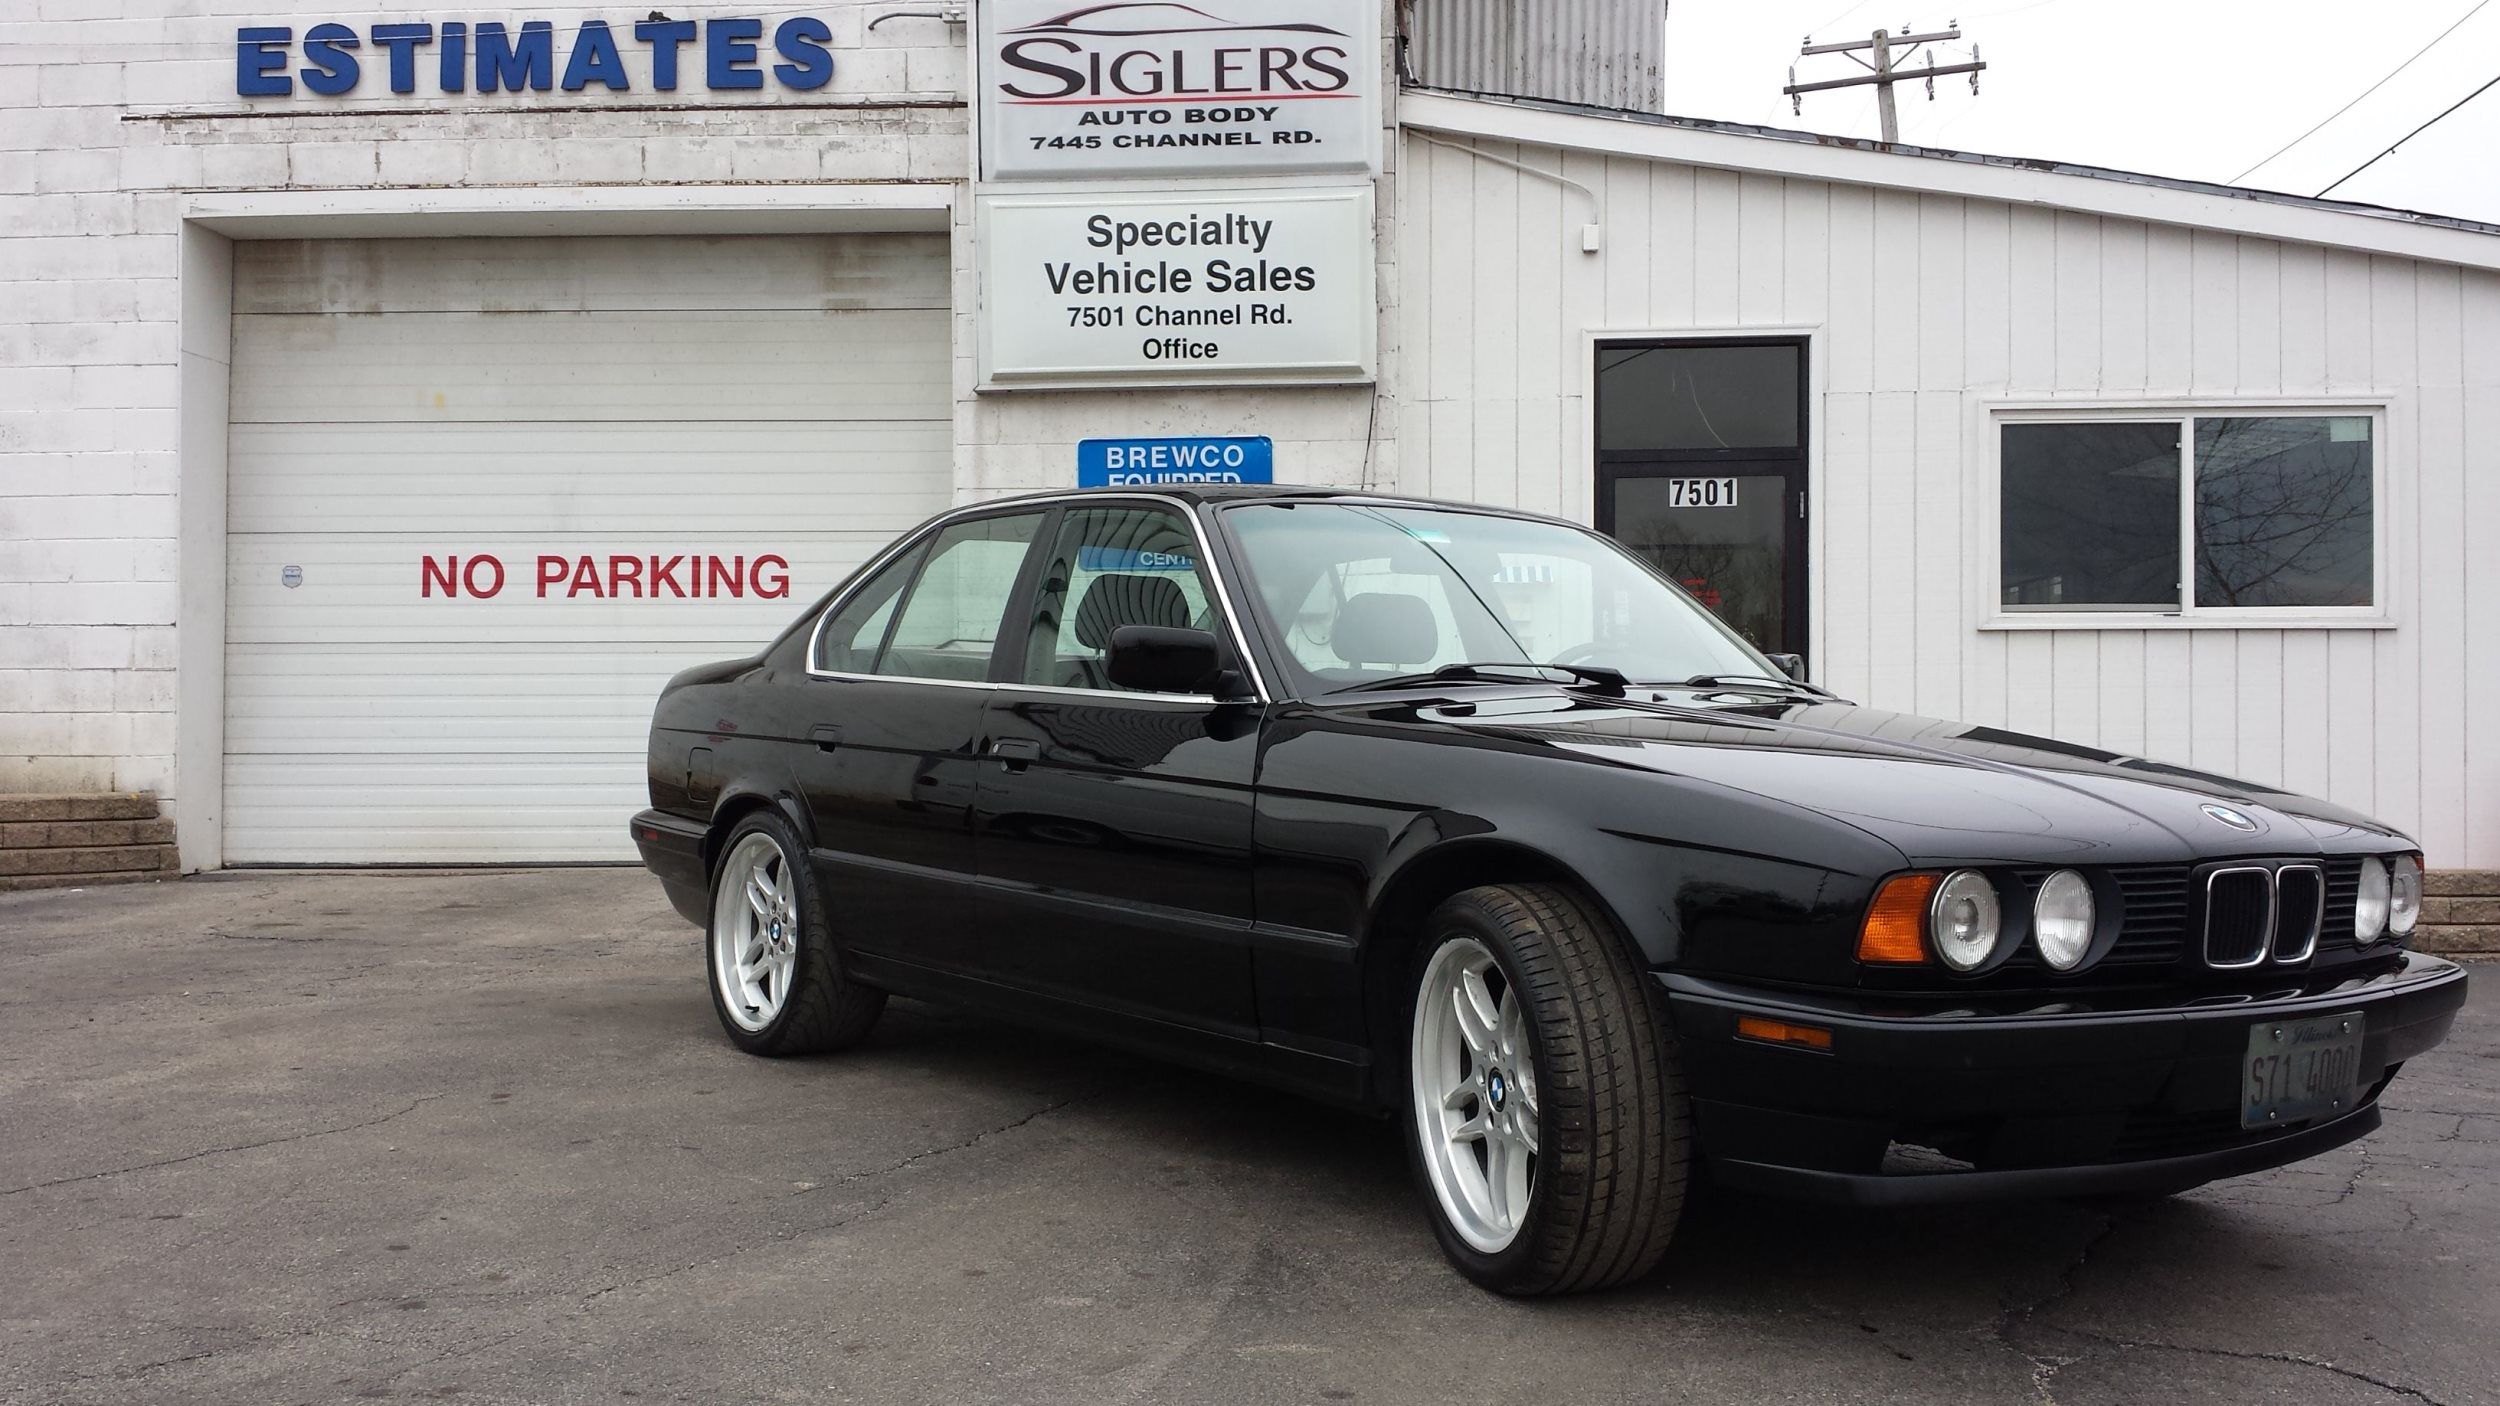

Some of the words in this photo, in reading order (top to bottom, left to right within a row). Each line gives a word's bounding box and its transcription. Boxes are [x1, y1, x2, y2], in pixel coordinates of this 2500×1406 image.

[237, 17, 833, 96] ESTIMATES
[999, 37, 1349, 99] SIGLERS
[1078, 109, 1171, 126] AUTO
[1185, 106, 1279, 124] BODY
[1030, 136, 1101, 150] 7445
[1112, 132, 1261, 148] CHANNEL
[1272, 131, 1321, 145] RD.
[1087, 213, 1272, 255] Specialty
[1045, 261, 1192, 295] Vehicle
[1206, 259, 1315, 293] Sales
[1067, 306, 1124, 327] 7501
[1135, 304, 1241, 326] Channel
[1251, 303, 1292, 325] Rd.
[1142, 337, 1218, 359] Office
[1106, 444, 1244, 469] BREWCO
[1671, 479, 1735, 506] 7501
[422, 553, 505, 599] NO
[536, 553, 790, 599] PARKING
